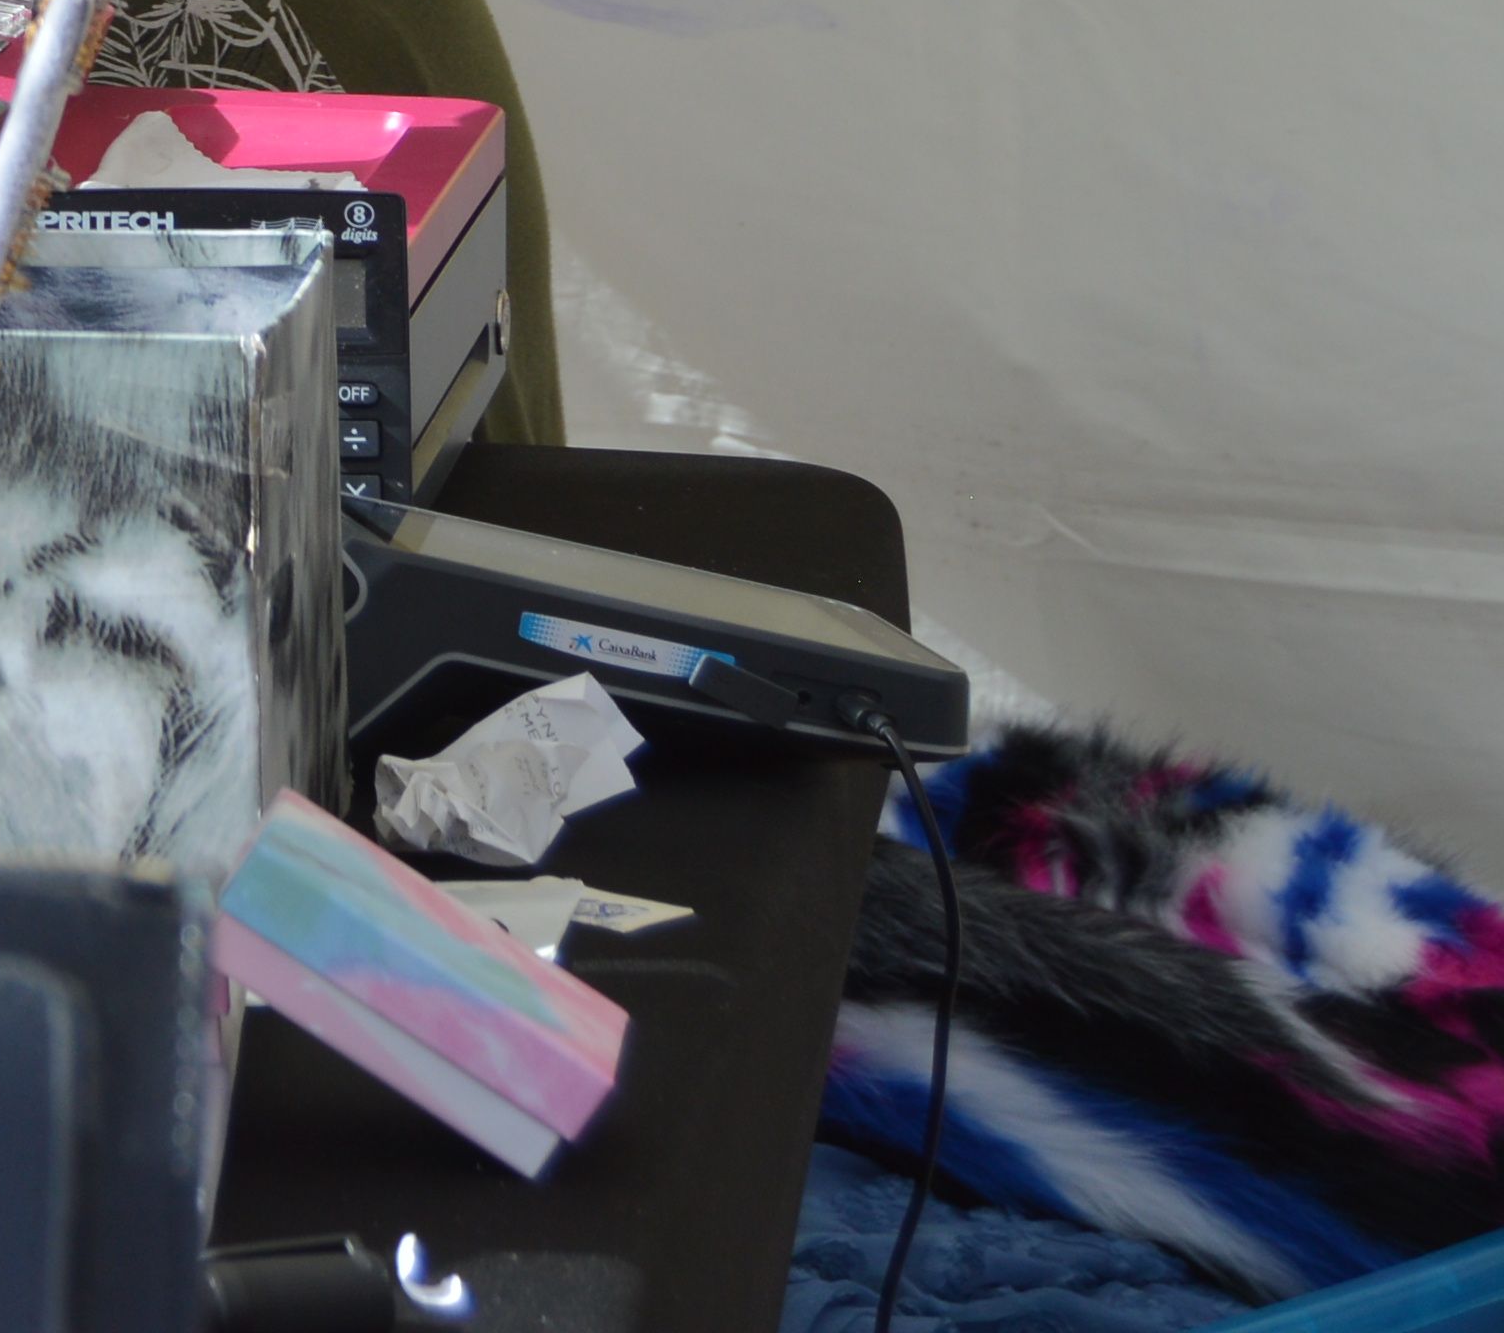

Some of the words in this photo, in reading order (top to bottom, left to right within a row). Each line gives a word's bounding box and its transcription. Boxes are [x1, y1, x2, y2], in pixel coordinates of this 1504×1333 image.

[37, 210, 175, 232] PRITECH
[341, 229, 379, 244] digits
[339, 387, 370, 402] OFF
[598, 638, 657, 662] CaixaBank
